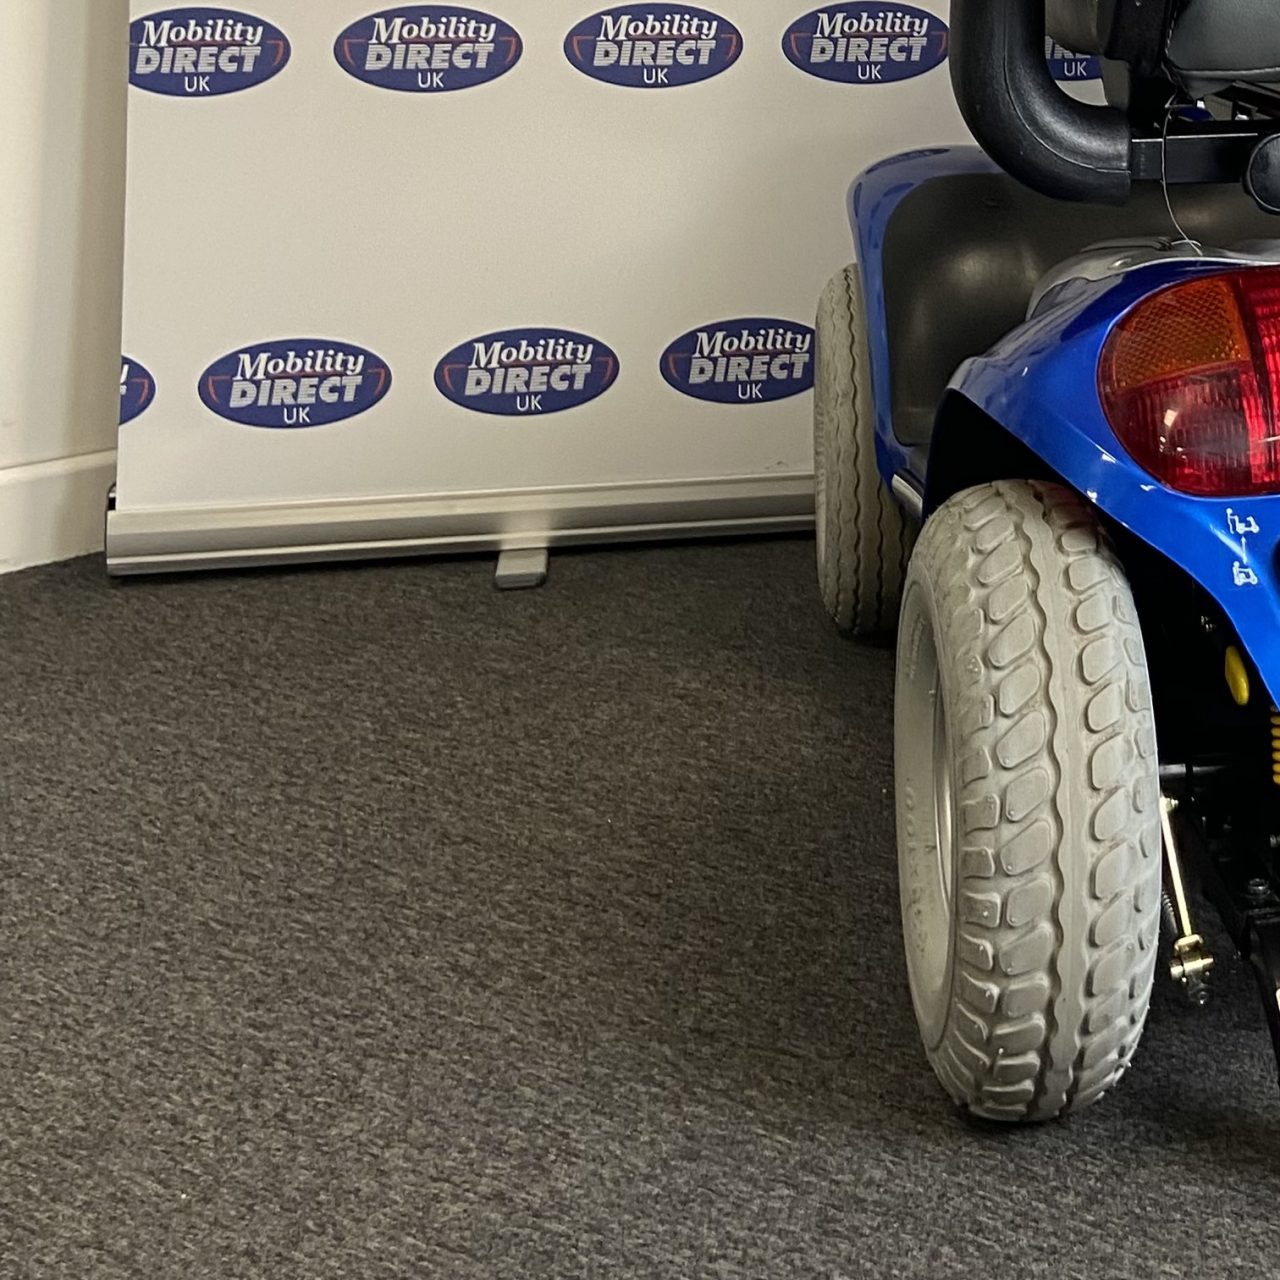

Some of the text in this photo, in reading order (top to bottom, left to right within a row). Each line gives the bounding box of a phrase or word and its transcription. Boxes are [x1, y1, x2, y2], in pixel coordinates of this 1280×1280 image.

[140, 20, 264, 48] Mobility
[372, 18, 496, 43] Mobility
[597, 15, 716, 41] Mobility
[815, 12, 929, 38] Mobility
[137, 47, 262, 75] DIRECT
[366, 44, 495, 71] DIRECT
[595, 41, 716, 67] DIRECT
[810, 37, 927, 63] DIRECT
[419, 73, 444, 87] UK
[645, 69, 668, 84] UK
[858, 64, 882, 80] UK
[1064, 61, 1087, 76] UK
[186, 78, 210, 93] UK
[470, 340, 594, 367] Mobility
[692, 328, 812, 358] Mobility
[234, 351, 365, 381] Mobility
[689, 353, 810, 384] DIRECT
[231, 377, 363, 408] DIRECT
[466, 366, 592, 396] DIRECT
[738, 382, 763, 400] UK
[285, 408, 311, 424] UK
[518, 396, 542, 412] UK
